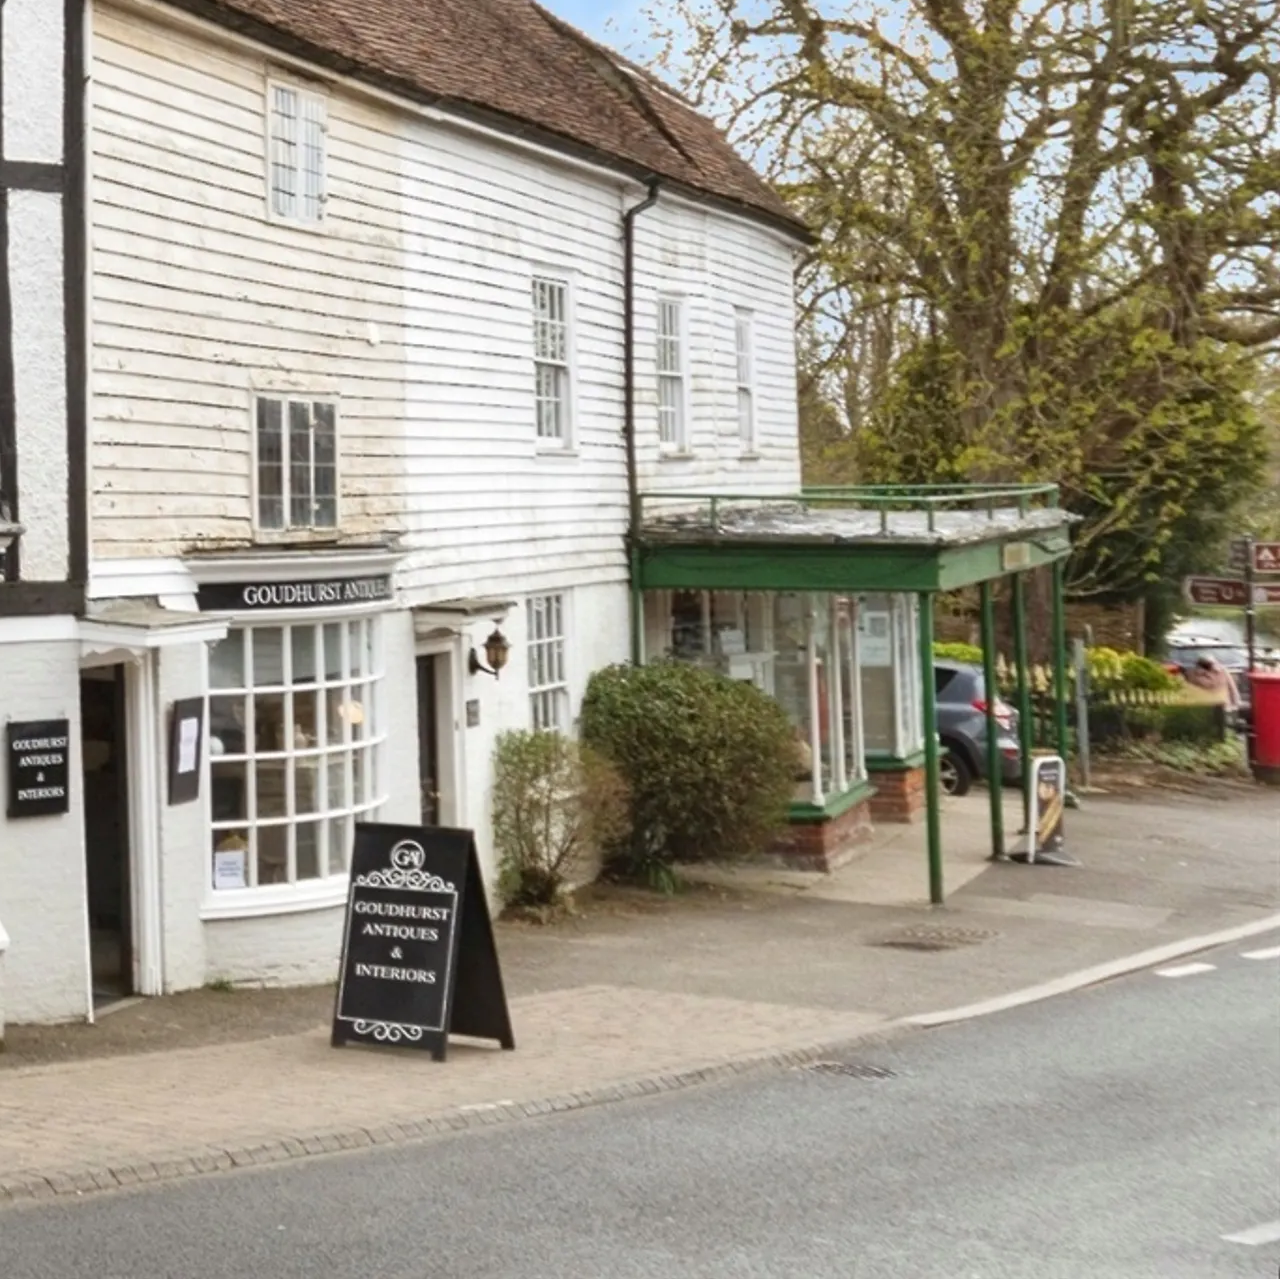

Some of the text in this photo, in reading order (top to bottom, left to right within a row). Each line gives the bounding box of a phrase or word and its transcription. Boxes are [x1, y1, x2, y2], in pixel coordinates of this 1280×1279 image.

[243, 582, 341, 606] GOUDHURST
[12, 736, 68, 751] GOUDHURST
[19, 753, 64, 767] ANTIQUES
[17, 786, 65, 801] INTERIORS
[354, 900, 451, 921] GOUDHURST
[362, 922, 440, 941] ANTIQUES
[390, 945, 403, 960] &
[355, 962, 437, 984] INTERIORS
